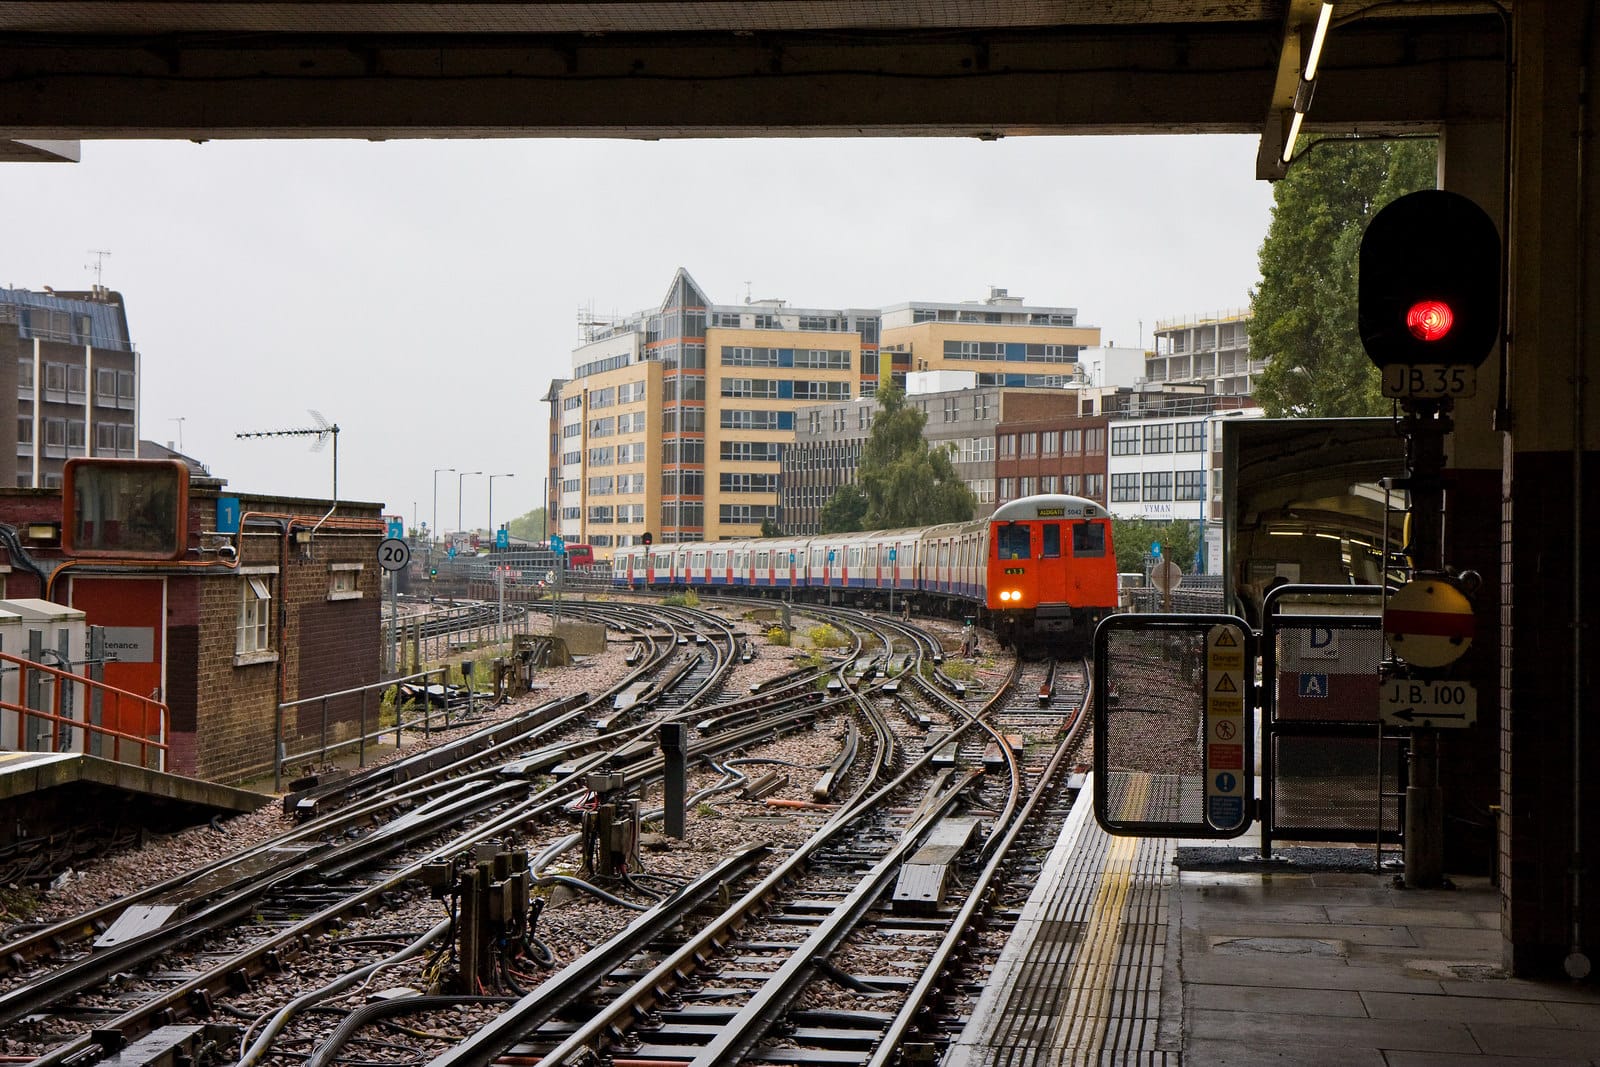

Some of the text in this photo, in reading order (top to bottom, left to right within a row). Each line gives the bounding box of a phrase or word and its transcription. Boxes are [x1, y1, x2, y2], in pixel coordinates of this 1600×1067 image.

[225, 507, 232, 524] 1
[499, 533, 506, 544] 3
[383, 547, 404, 563] 20
